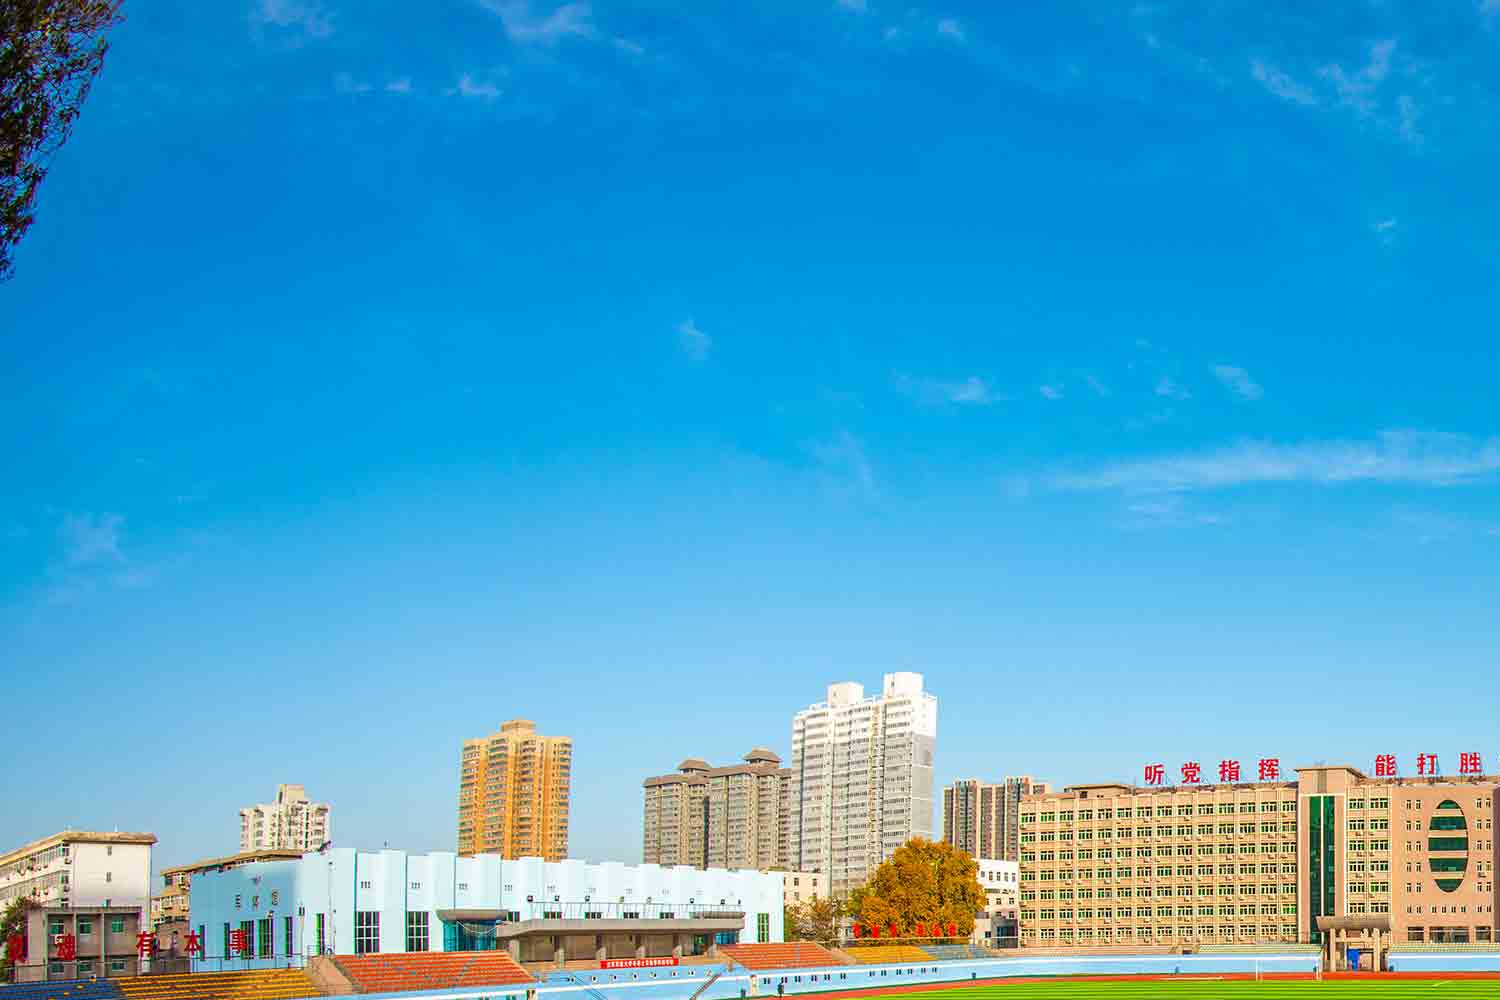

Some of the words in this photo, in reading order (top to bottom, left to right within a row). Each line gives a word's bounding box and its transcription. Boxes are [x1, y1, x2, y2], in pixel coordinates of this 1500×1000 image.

[1144, 758, 1280, 785] 听党指挥
[136, 928, 248, 957] 有本事
